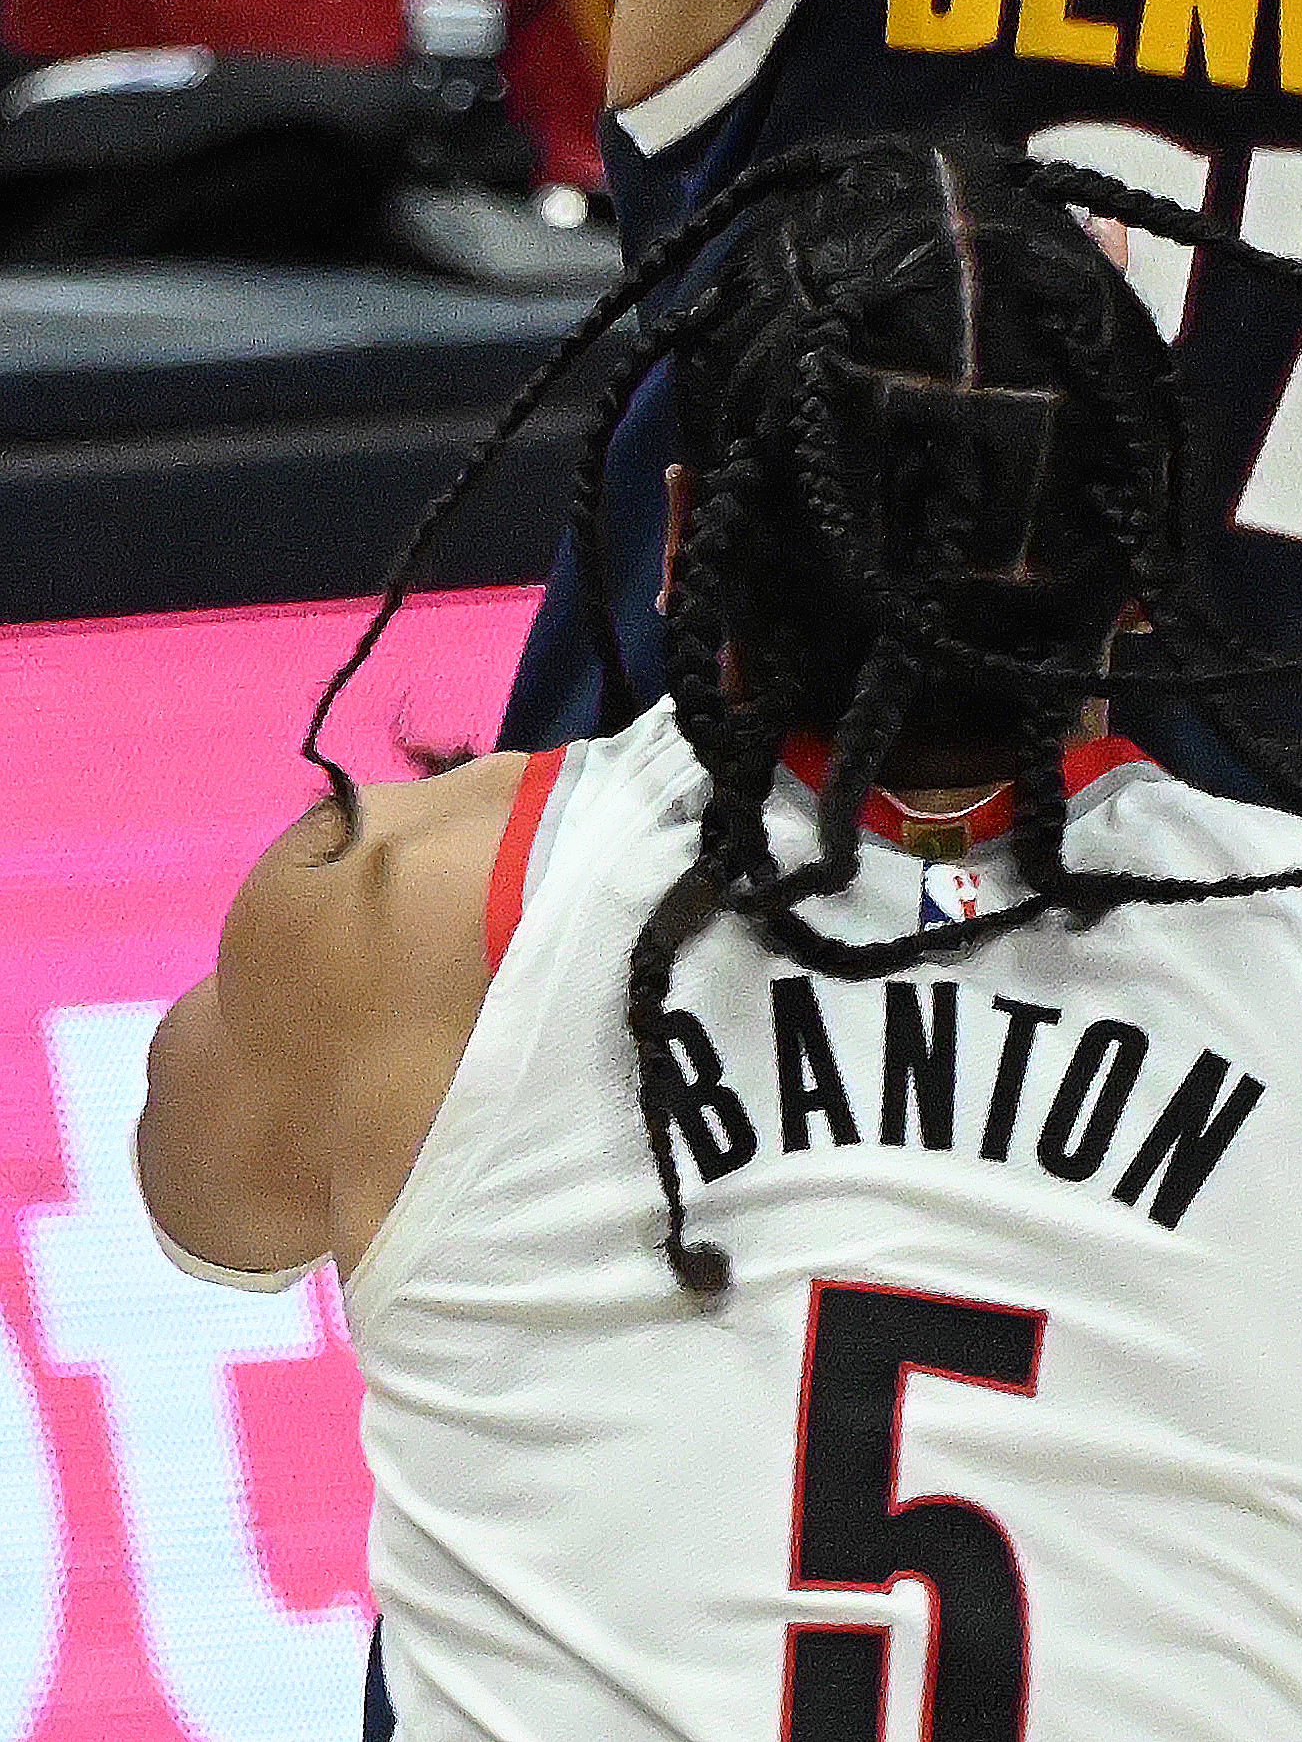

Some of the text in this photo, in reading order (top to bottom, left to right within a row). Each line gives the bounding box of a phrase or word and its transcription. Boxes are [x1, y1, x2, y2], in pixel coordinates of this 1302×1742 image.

[655, 973, 1267, 1231] BANTON
[0, 998, 375, 1742] t
[780, 1278, 1048, 1742] 5
